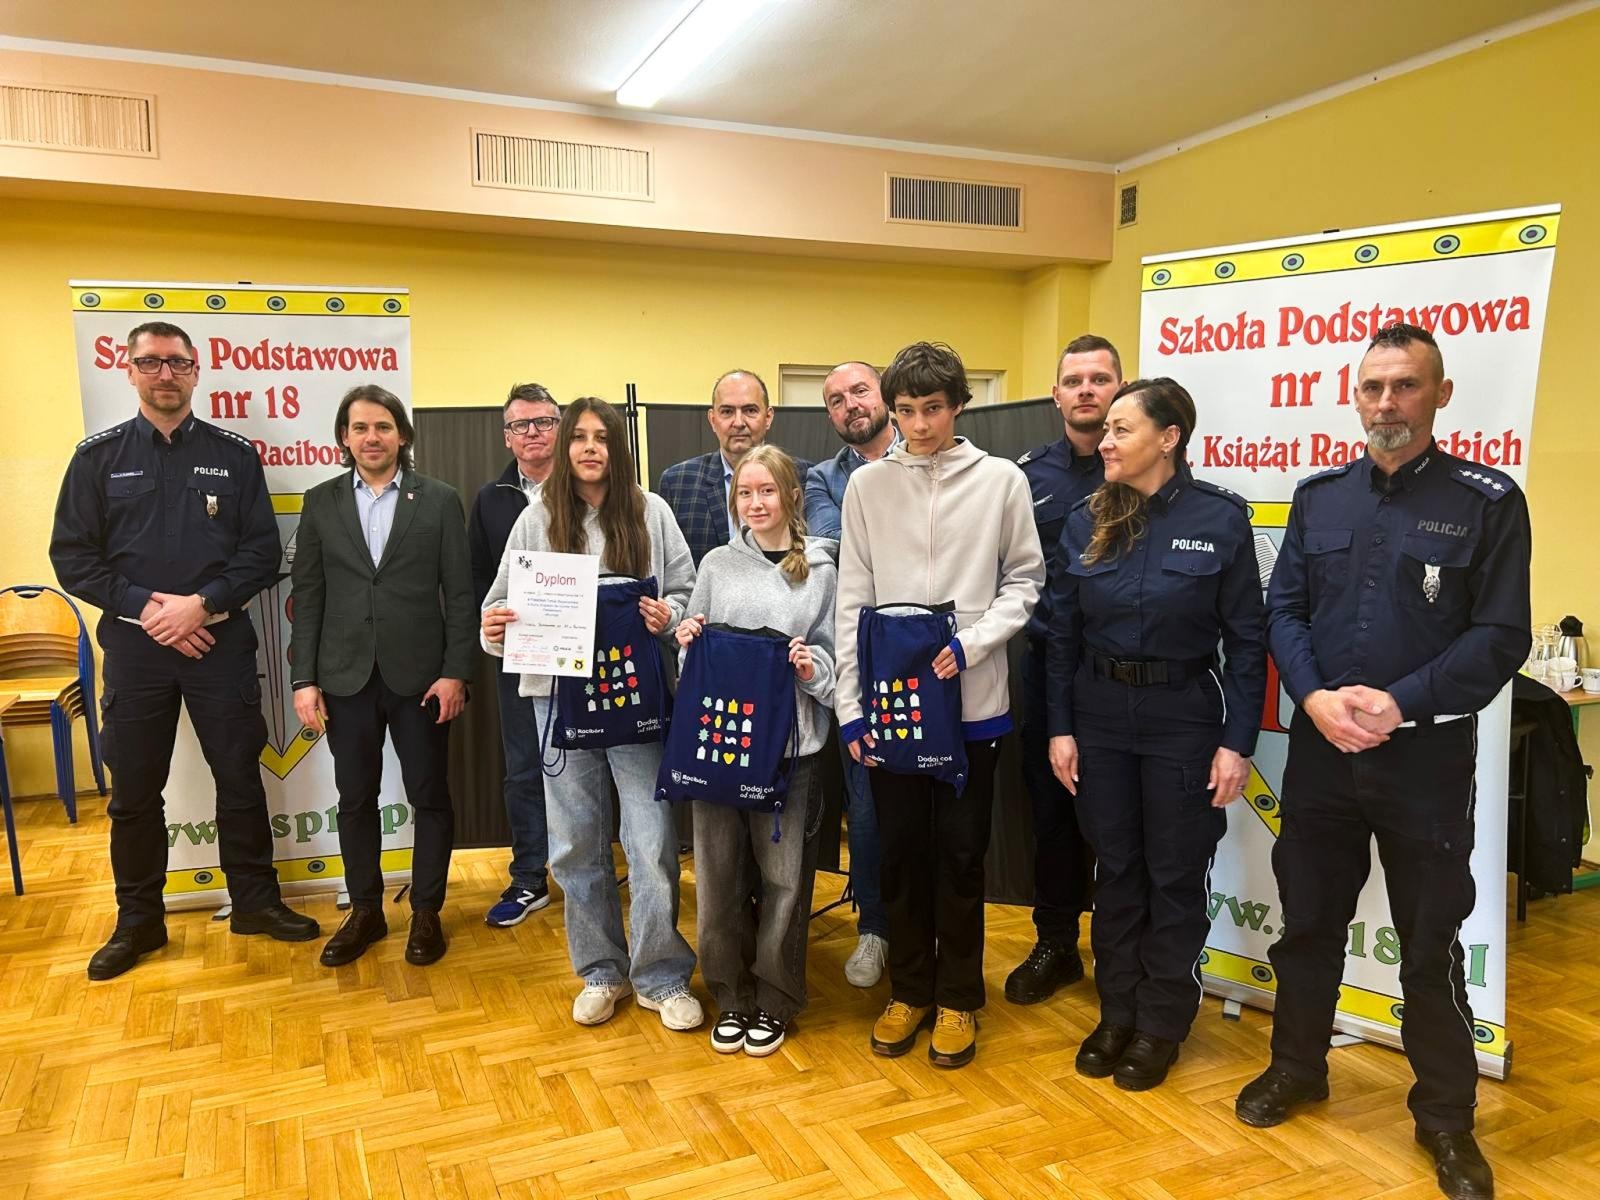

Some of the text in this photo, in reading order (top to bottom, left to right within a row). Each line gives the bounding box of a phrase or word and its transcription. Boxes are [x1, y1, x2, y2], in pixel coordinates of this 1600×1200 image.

[1158, 296, 1530, 355] Szkoła Podstawowa
[209, 338, 398, 371] Podstawowa
[1271, 364, 1350, 408] nr 1
[210, 386, 301, 419] nr 18
[1203, 435, 1300, 472] Książąt
[194, 466, 229, 478] POLICJA
[1417, 519, 1468, 537] POLICJA
[1171, 538, 1215, 553] POLICJA
[535, 572, 577, 588] Dyplom
[917, 755, 939, 763] Dodaj
[740, 784, 763, 794] Dodaj
